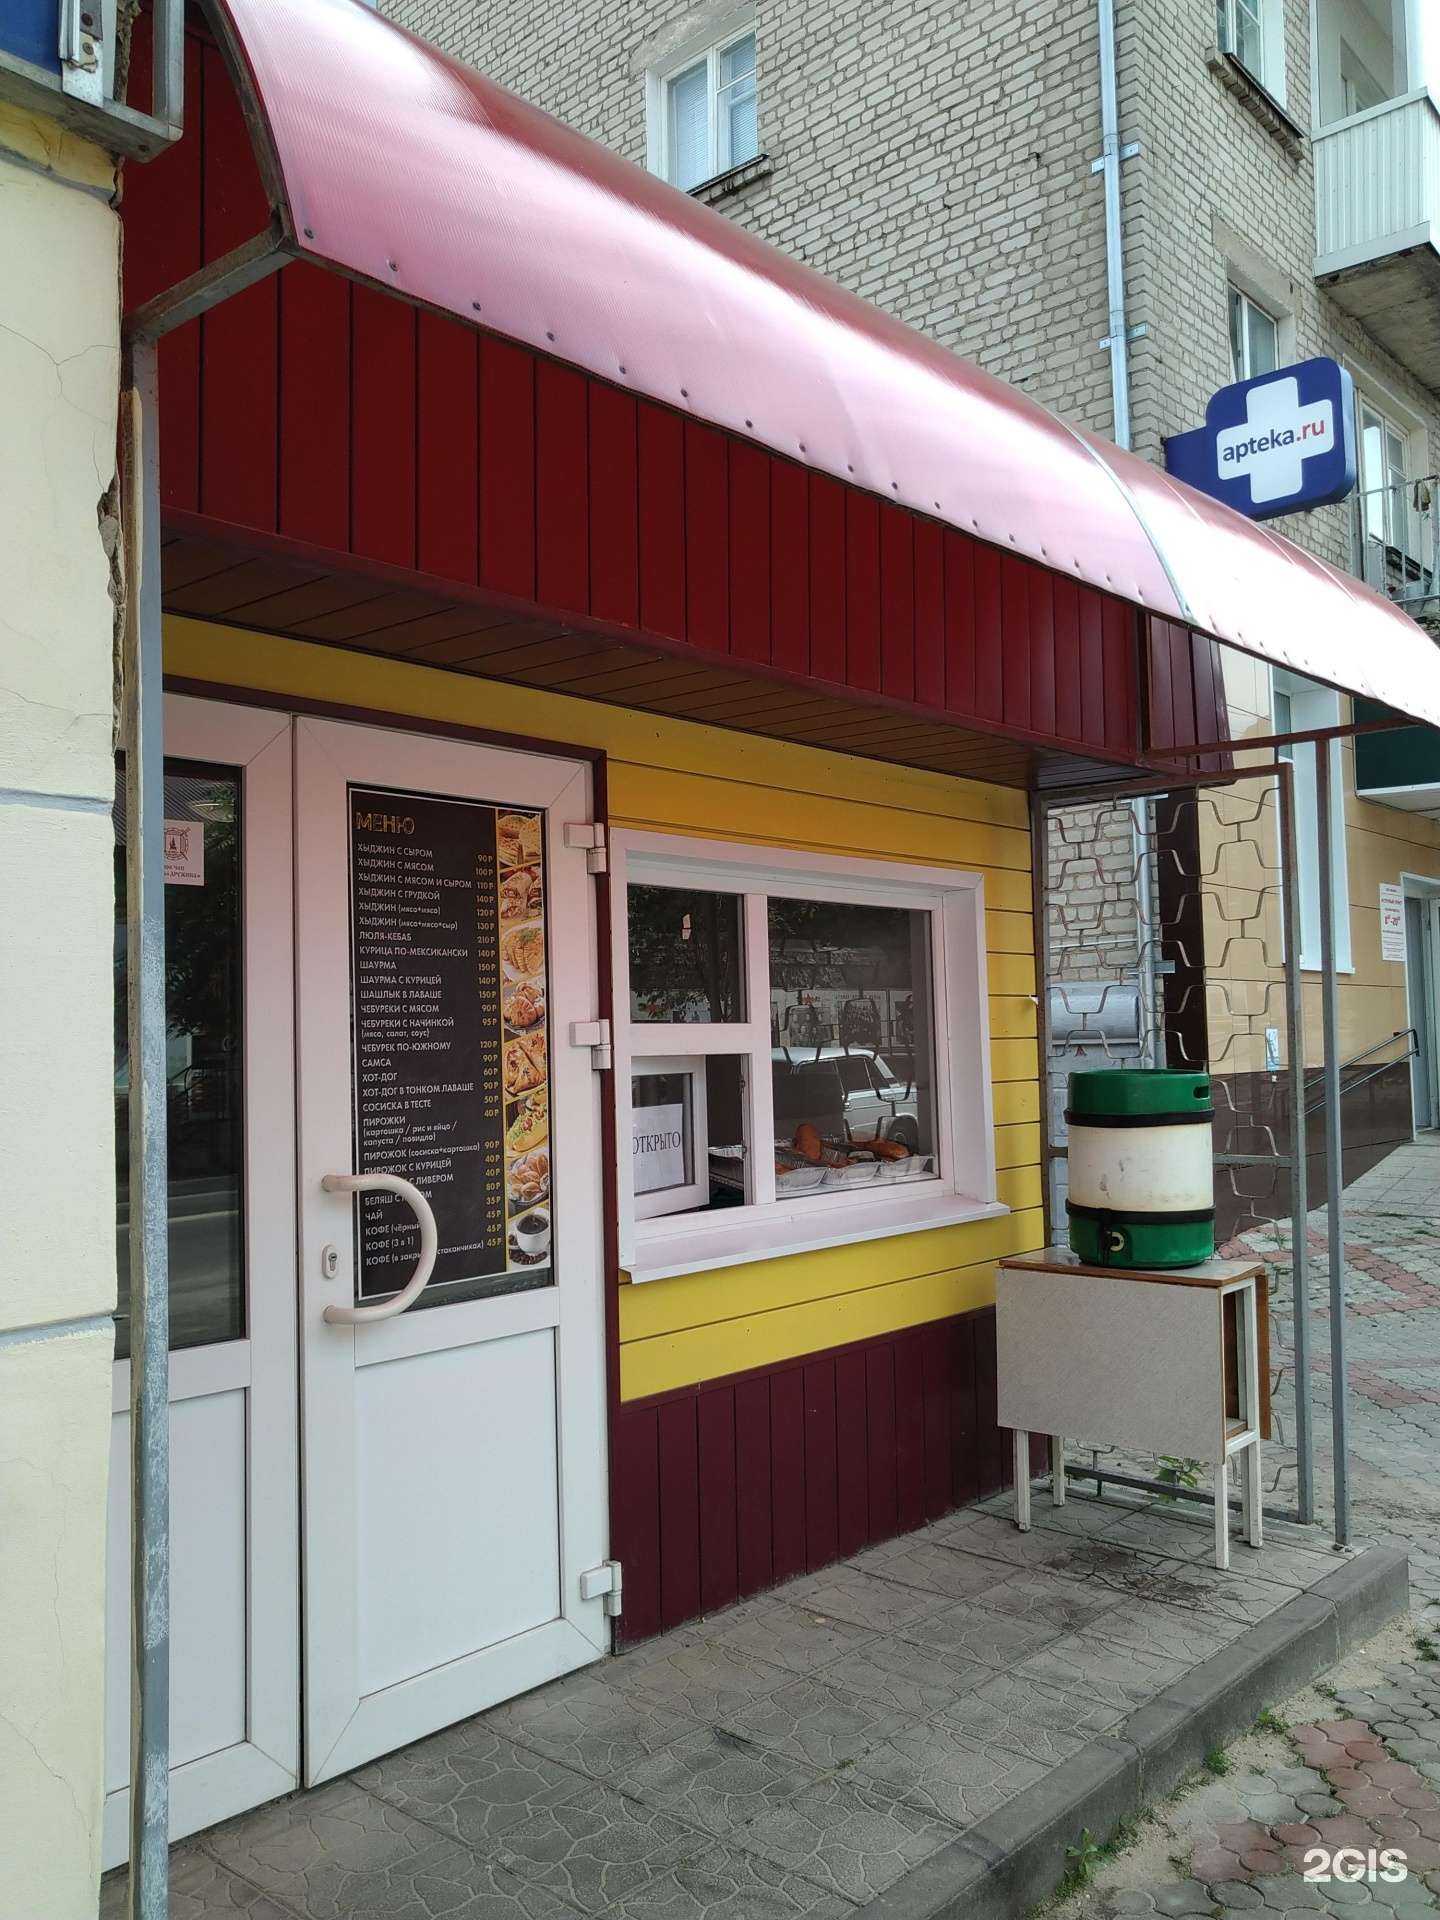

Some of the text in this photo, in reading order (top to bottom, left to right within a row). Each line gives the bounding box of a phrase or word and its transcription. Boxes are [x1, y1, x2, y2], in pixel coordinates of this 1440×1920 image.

[1222, 419, 1325, 463] apteka.ru
[356, 812, 415, 834] МЕНЮ
[404, 847, 433, 858] СЫРОМ
[404, 861, 434, 871] МЯСОМ
[404, 876, 435, 886] МЯСОМ
[443, 879, 472, 888] СЫРОМ
[405, 890, 440, 900] ГРУДКОЙ
[359, 931, 412, 941] ЛЮЛЯ-КЕБАБ
[360, 946, 393, 956] КУРИЦА
[394, 947, 468, 957] ПО-МЕКСИКАНСКИ
[360, 961, 397, 969] ШАУРМА
[360, 976, 397, 984] ШАУРМА
[405, 974, 442, 985] КУРИЦЕЙ
[360, 990, 400, 999] ШАШЛЫК
[408, 990, 443, 999] ЛАВАШЕ
[361, 1005, 400, 1013] ЧЕБУРЕКИ
[409, 1004, 439, 1013] МЯСОМ
[361, 1019, 400, 1028] ЧЕБУРЕКИ
[409, 1017, 454, 1027] НАЧИНКОЙ
[361, 1043, 395, 1052] ЧЕБУРЕК
[397, 1042, 451, 1051] ПО-ЮЖНОМУ
[361, 1058, 392, 1068] САМСА
[362, 1072, 398, 1082] ХОТ-ДОГ
[362, 1087, 398, 1097] ХОТ-ДОГ
[406, 1085, 440, 1094] ТОНКОМ
[441, 1082, 474, 1092] ЛАВАШЕ
[362, 1102, 402, 1112] СОСИСКА
[411, 1099, 432, 1109] ТЕСТЕ
[363, 1116, 406, 1126] ПИРОЖКИ
[412, 1125, 426, 1134] рис
[363, 1138, 394, 1147] капуста
[632, 1131, 681, 1155] ОТКРЫТО
[364, 1149, 407, 1160] ПИРОЖОК
[364, 1164, 407, 1174] ПИРОЖОК
[415, 1158, 452, 1171] КУРИЦЕЙ
[416, 1174, 454, 1185] ЛИВЕРОМ
[365, 1195, 393, 1206] БЕЛЯШ
[365, 1209, 383, 1221] ЧАЙ
[365, 1224, 390, 1236] КОФЕ
[366, 1239, 390, 1251] КОФЕ
[366, 1254, 390, 1266] КОФЕ
